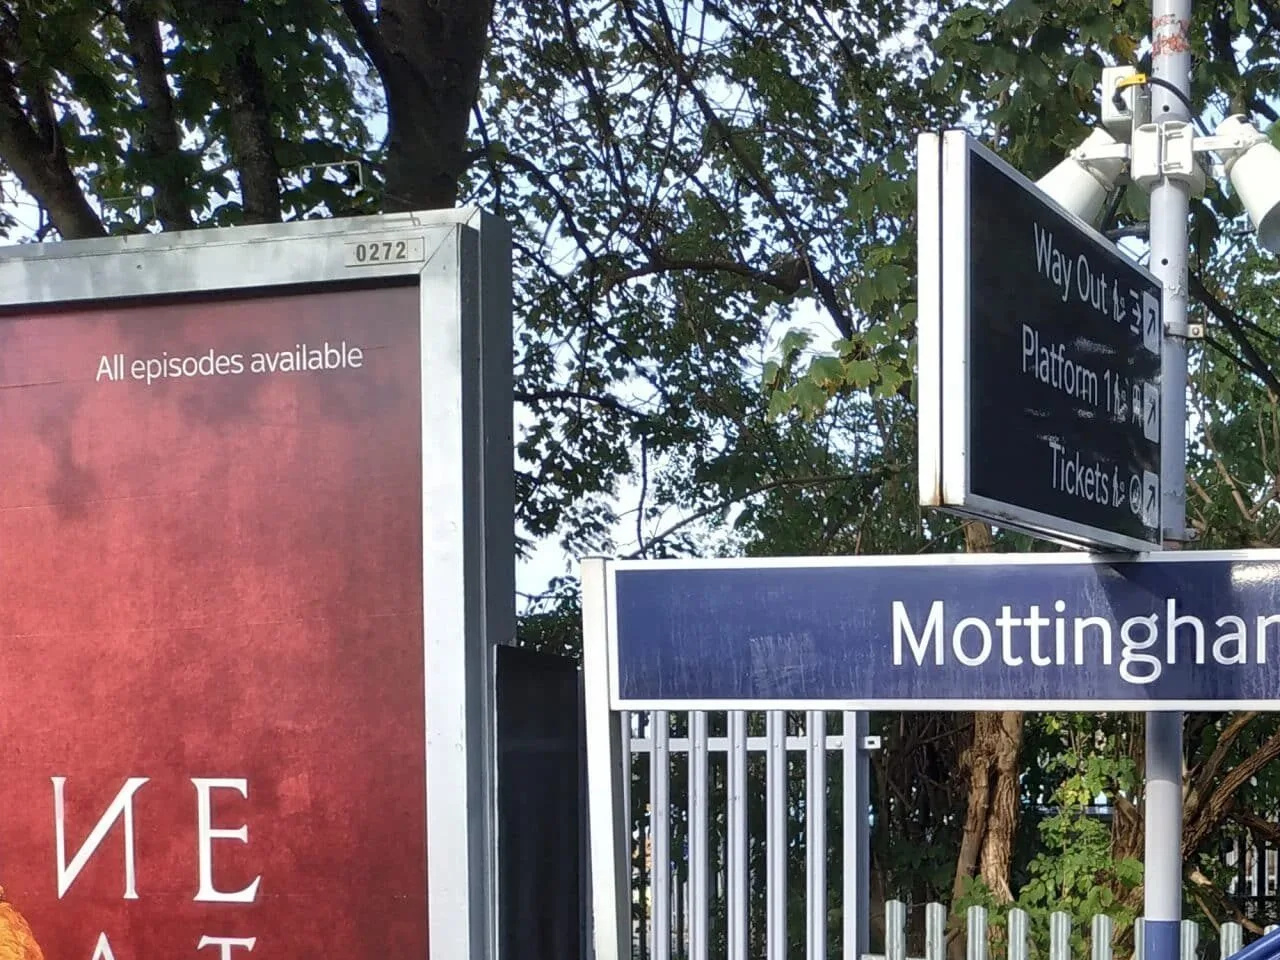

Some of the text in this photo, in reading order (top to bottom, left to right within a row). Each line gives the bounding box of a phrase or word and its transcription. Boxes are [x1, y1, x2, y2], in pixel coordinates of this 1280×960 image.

[356, 241, 407, 263] 0272
[1033, 222, 1108, 314] Way Out
[96, 341, 363, 385] All episodes available
[1022, 325, 1112, 412] Platform 1
[1048, 439, 1109, 506] Tickets
